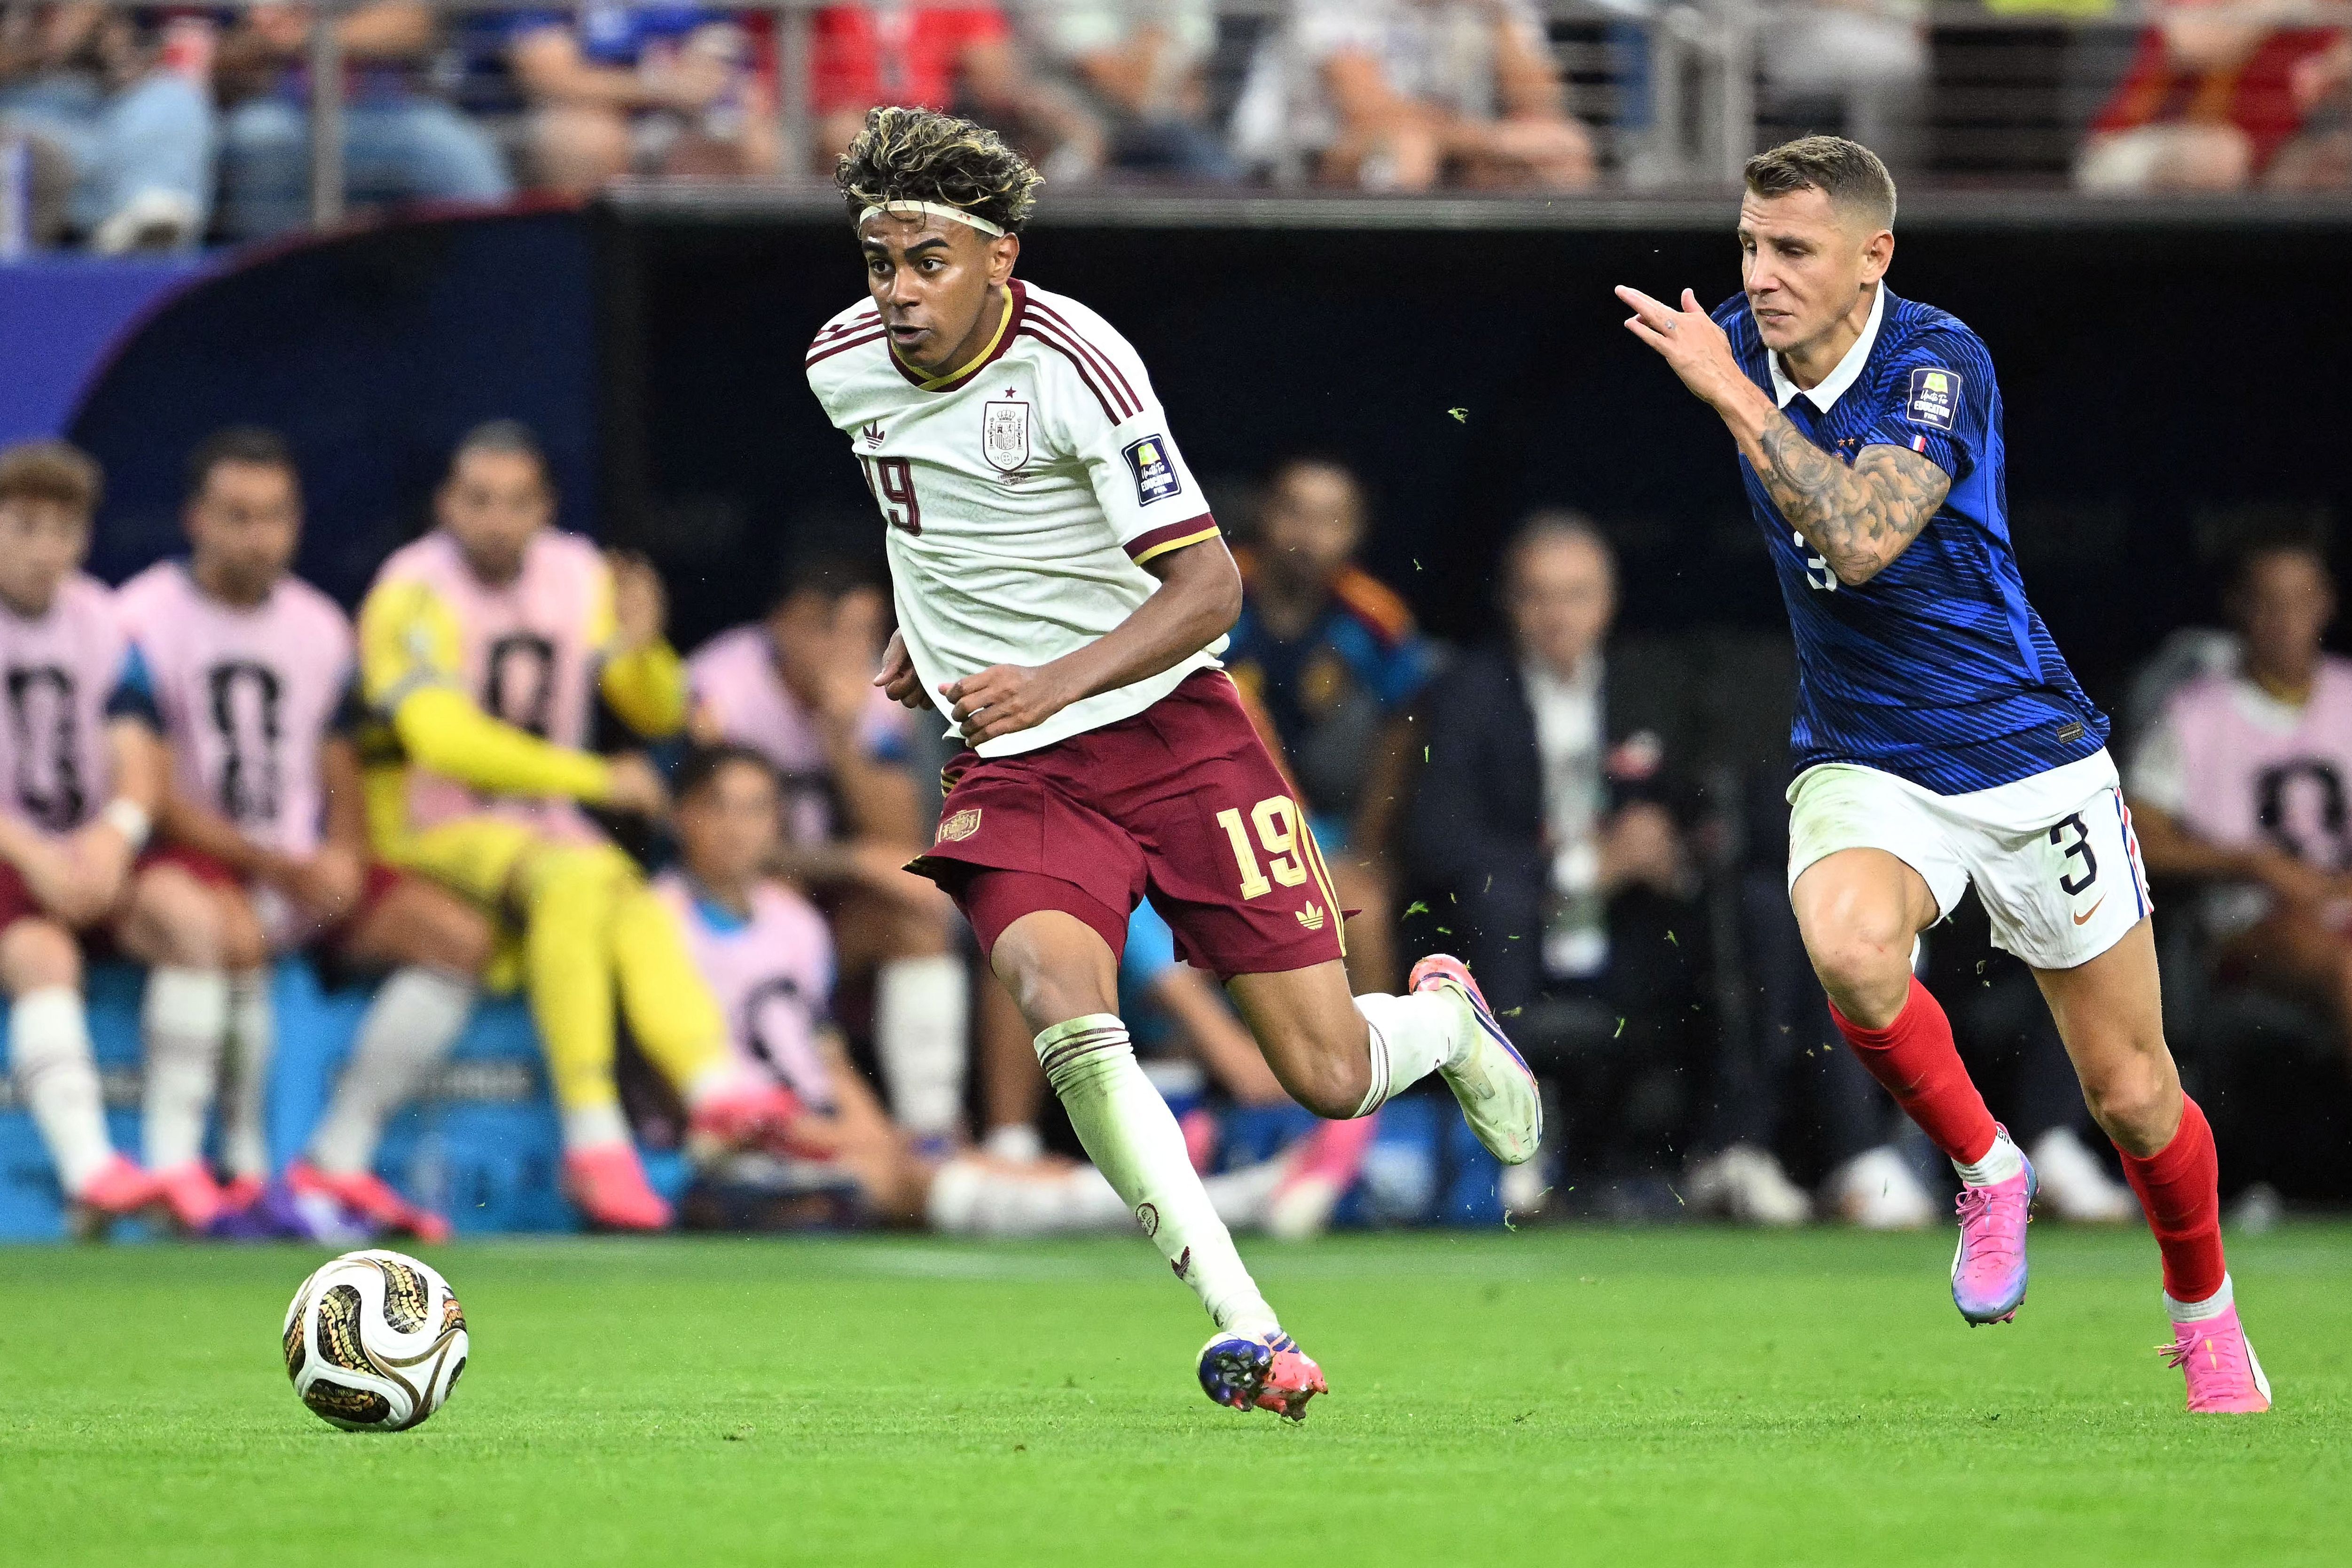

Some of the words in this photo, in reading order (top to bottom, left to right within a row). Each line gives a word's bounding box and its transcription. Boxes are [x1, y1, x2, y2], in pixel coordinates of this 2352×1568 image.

[1914, 400, 1950, 418] EDUCATION
[1923, 412, 1938, 421] FIFA
[1140, 472, 1173, 492] EDUCATION
[1216, 795, 1307, 900] 19
[2049, 811, 2098, 896] 3
[400, 1264, 428, 1318] ATLANT
